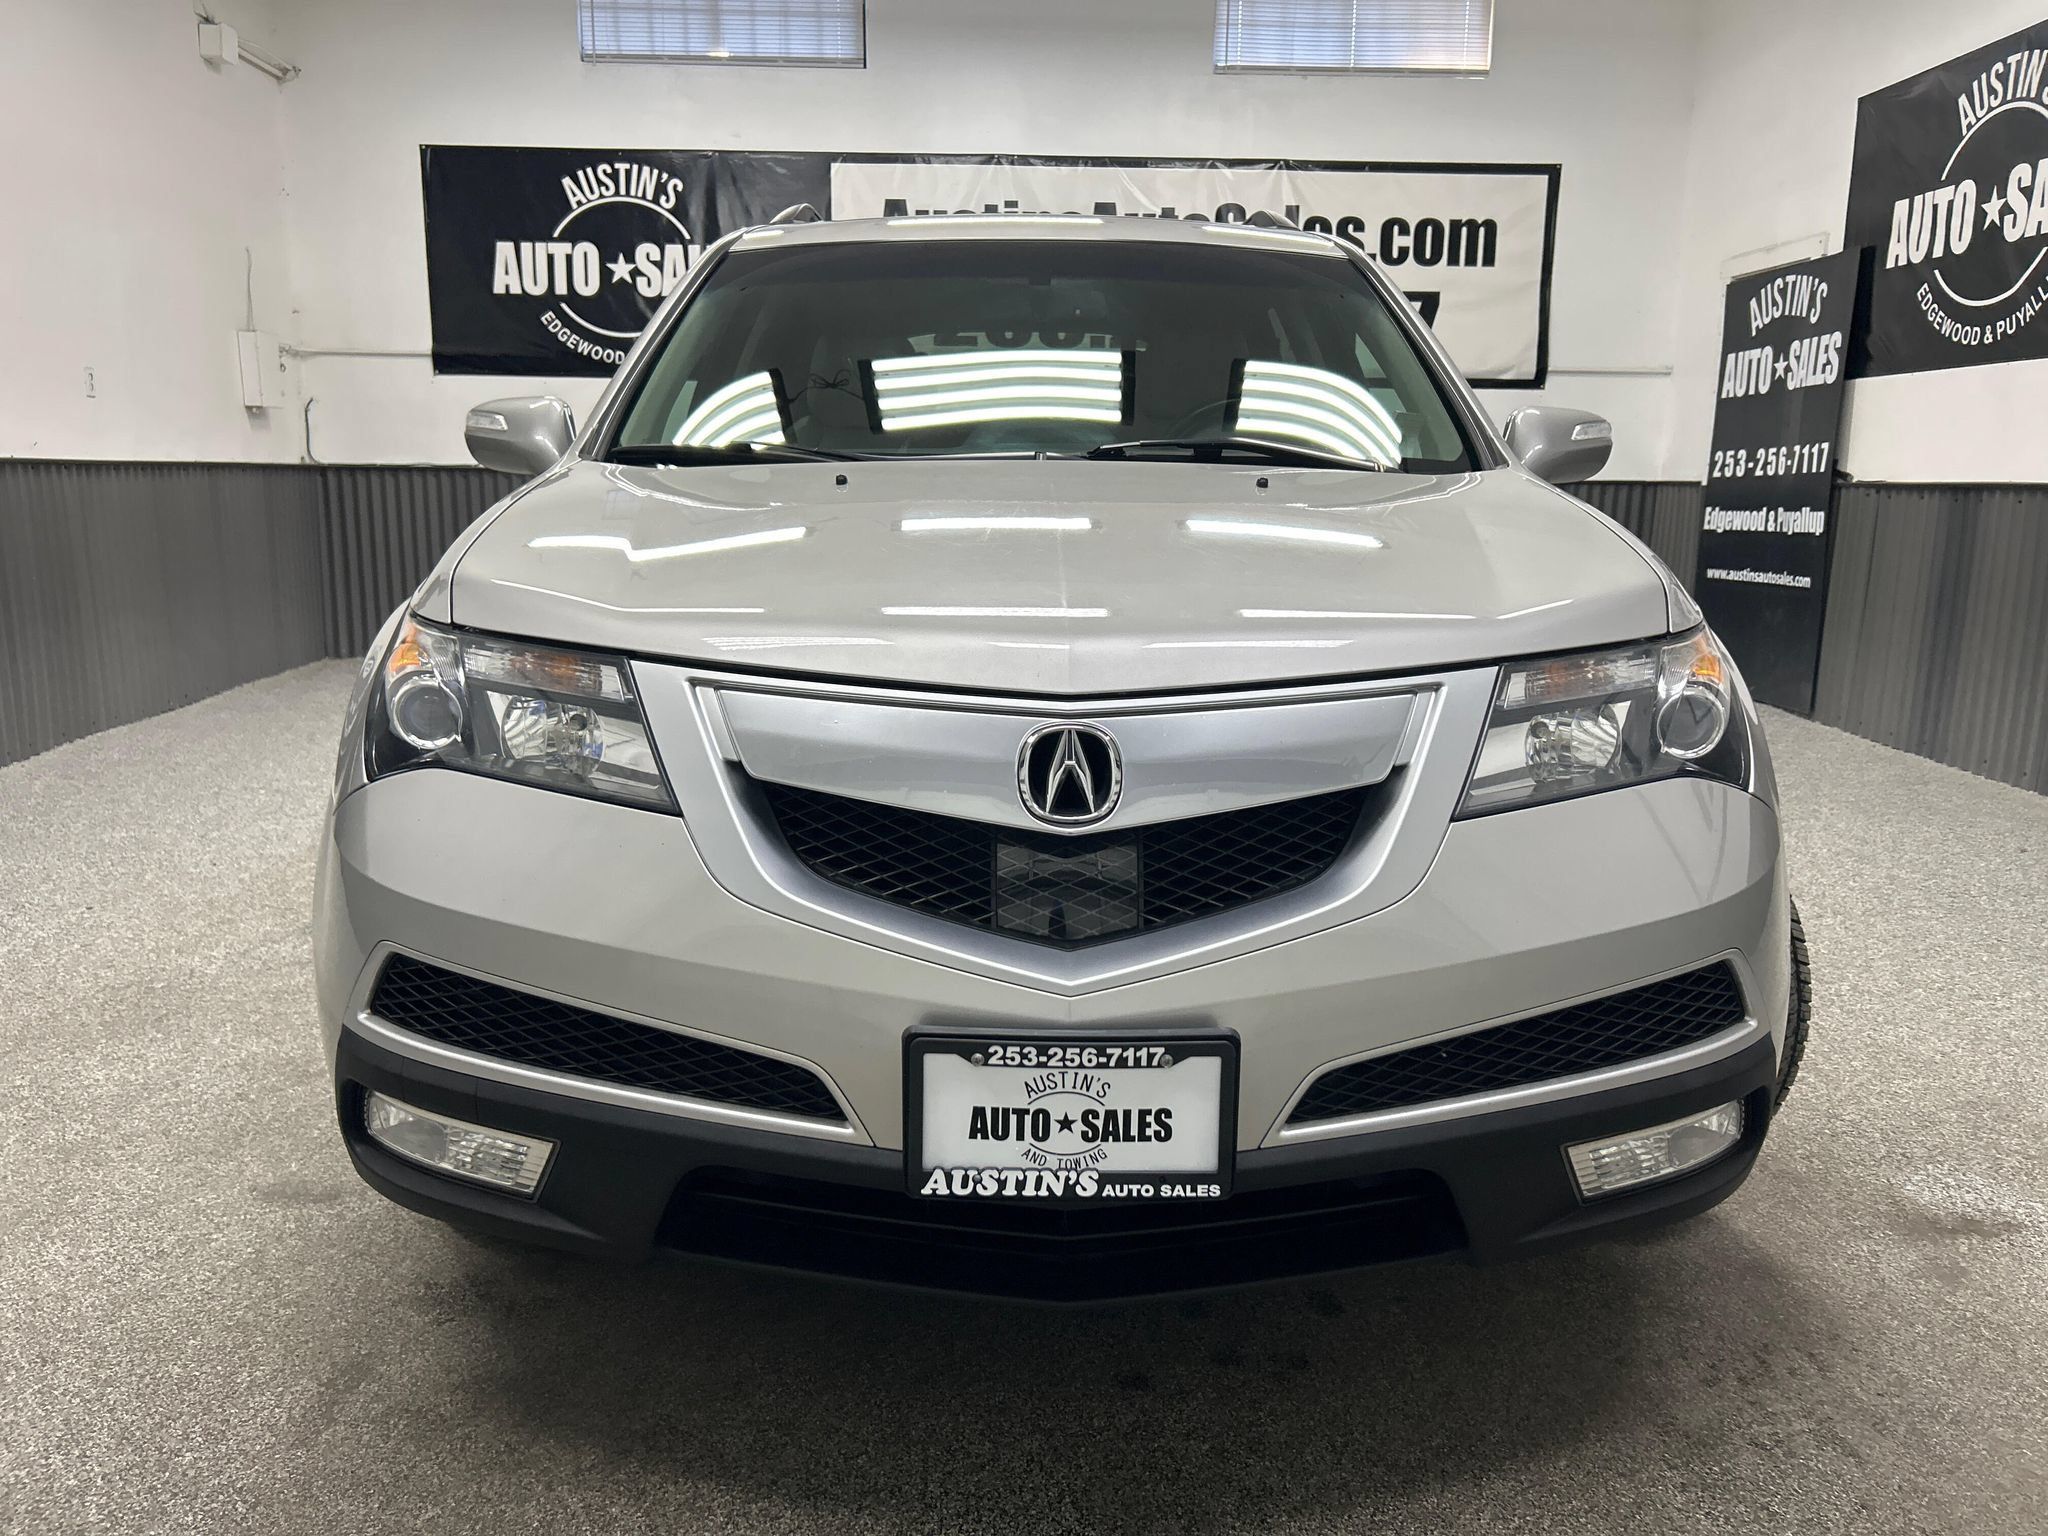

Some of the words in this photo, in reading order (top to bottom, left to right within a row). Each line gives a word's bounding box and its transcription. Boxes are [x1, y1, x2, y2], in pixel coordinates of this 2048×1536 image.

[561, 163, 684, 210] AUSTIN'S
[1886, 179, 1976, 269] AUTO
[493, 241, 600, 296] AUTO
[1749, 274, 1828, 337] AUSTIN'S
[1917, 282, 1981, 346] EDGEWOOD
[1983, 325, 1994, 345] &
[1996, 276, 2048, 341] PUYALL
[540, 311, 626, 365] EDGEWOOD
[1721, 345, 1773, 399] AUTO
[1787, 331, 1842, 390] SALES
[1712, 442, 1829, 478] 253-256-7117
[1703, 506, 1767, 533] Edgewood
[1767, 510, 1776, 532] &
[1777, 507, 1825, 536] Puyallup
[1706, 568, 1811, 588] www.austinsautosales.com
[987, 1045, 1165, 1067] 253-256-7117
[1024, 1071, 1111, 1099] AUSTIN'S
[968, 1105, 1051, 1142] AUTO
[1081, 1107, 1173, 1143] SALES
[1021, 1148, 1047, 1167] AND
[1057, 1147, 1108, 1169] TOWING
[921, 1168, 1099, 1198] AUSTIN'S
[1102, 1183, 1155, 1197] AUTO
[1160, 1183, 1221, 1198] SALES
